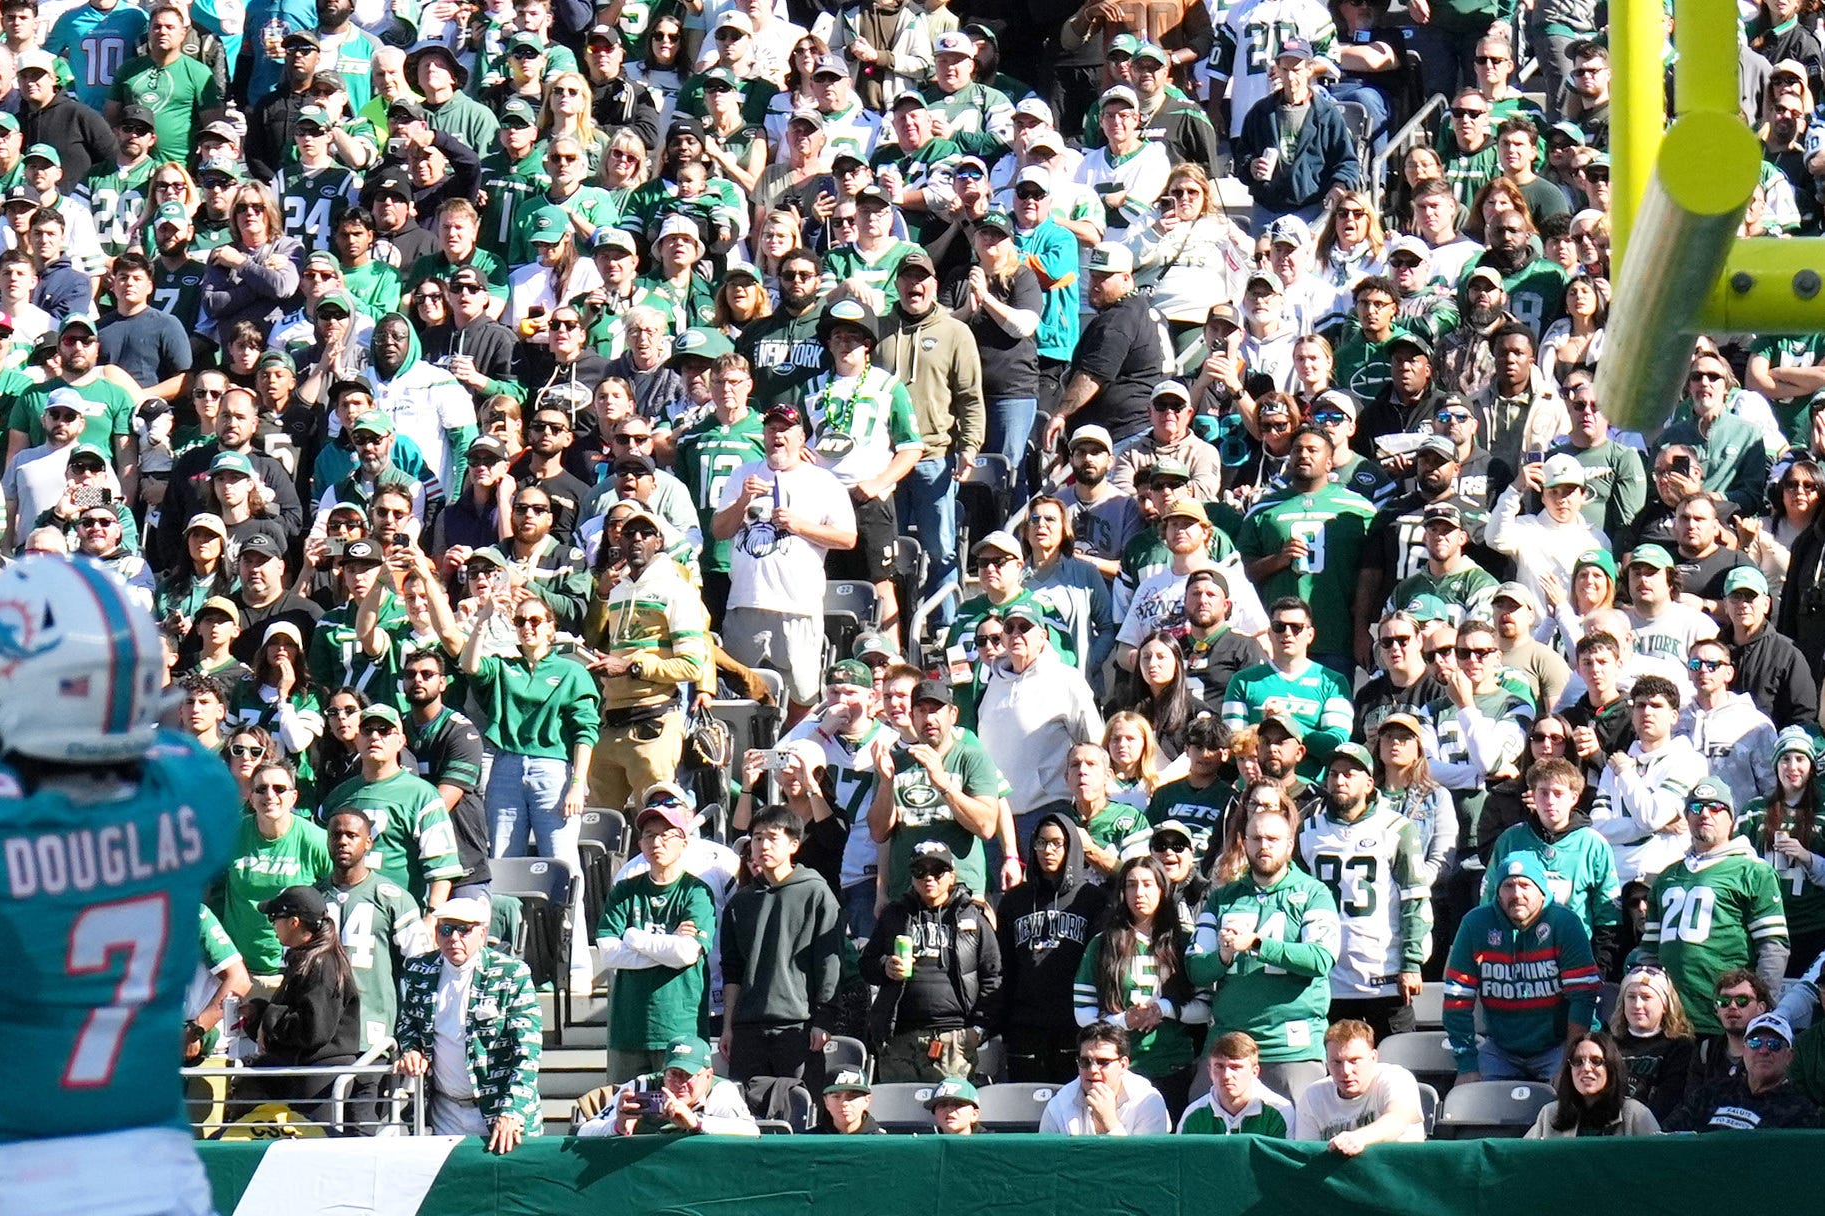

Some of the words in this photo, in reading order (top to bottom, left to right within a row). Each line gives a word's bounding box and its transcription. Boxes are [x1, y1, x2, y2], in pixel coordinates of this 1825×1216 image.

[82, 36, 123, 86] 10
[284, 196, 337, 249] 24
[759, 342, 791, 366] NEW
[791, 342, 825, 367] YORK
[1644, 636, 1683, 656] YORK
[1168, 804, 1220, 819] JETS
[4, 805, 203, 898] DOUGLAS
[1048, 913, 1088, 942] YORK
[1661, 888, 1715, 943] 20
[1481, 960, 1560, 984] DOLPHINS
[63, 890, 171, 1088] 7
[1480, 980, 1561, 1003] FOOTBALL
